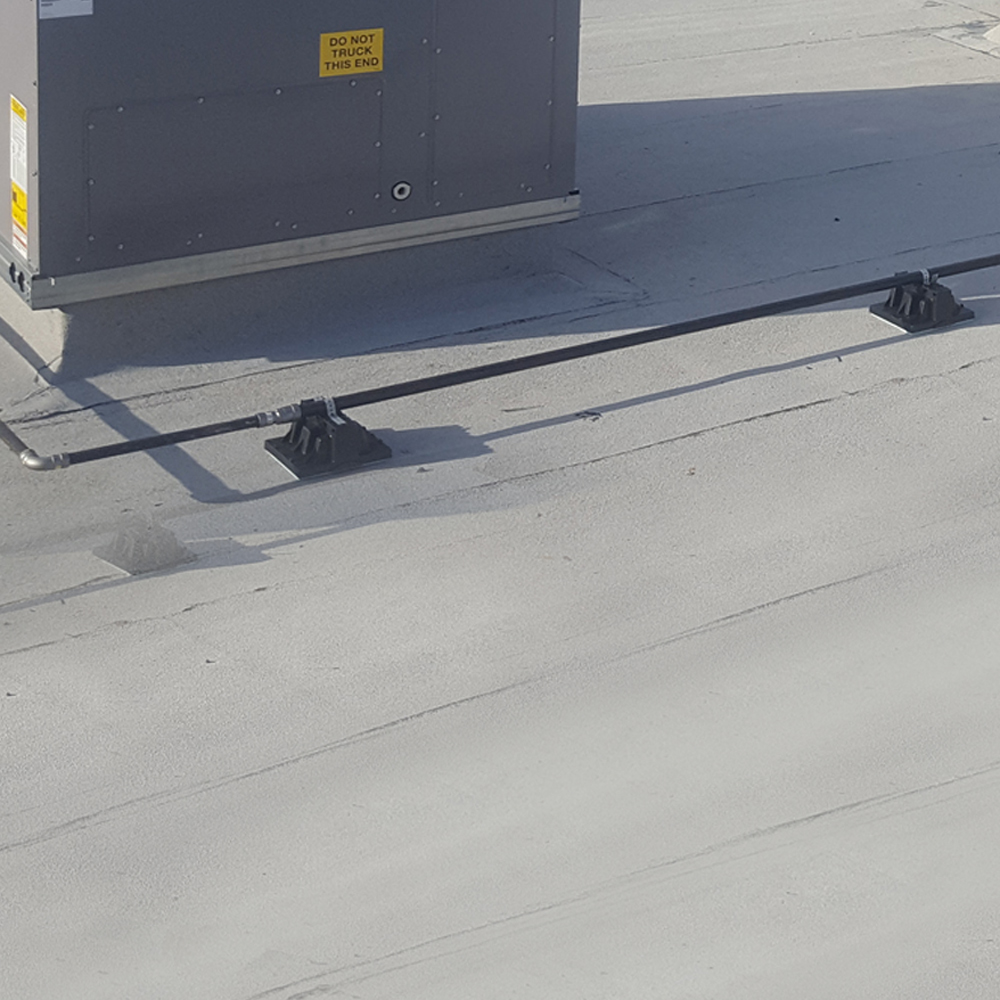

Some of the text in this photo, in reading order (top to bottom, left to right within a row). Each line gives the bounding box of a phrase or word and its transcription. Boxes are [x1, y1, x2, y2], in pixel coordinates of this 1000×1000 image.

[329, 34, 375, 46] DO NOT
[331, 46, 372, 58] TRUCK
[324, 57, 379, 70] THIS END
